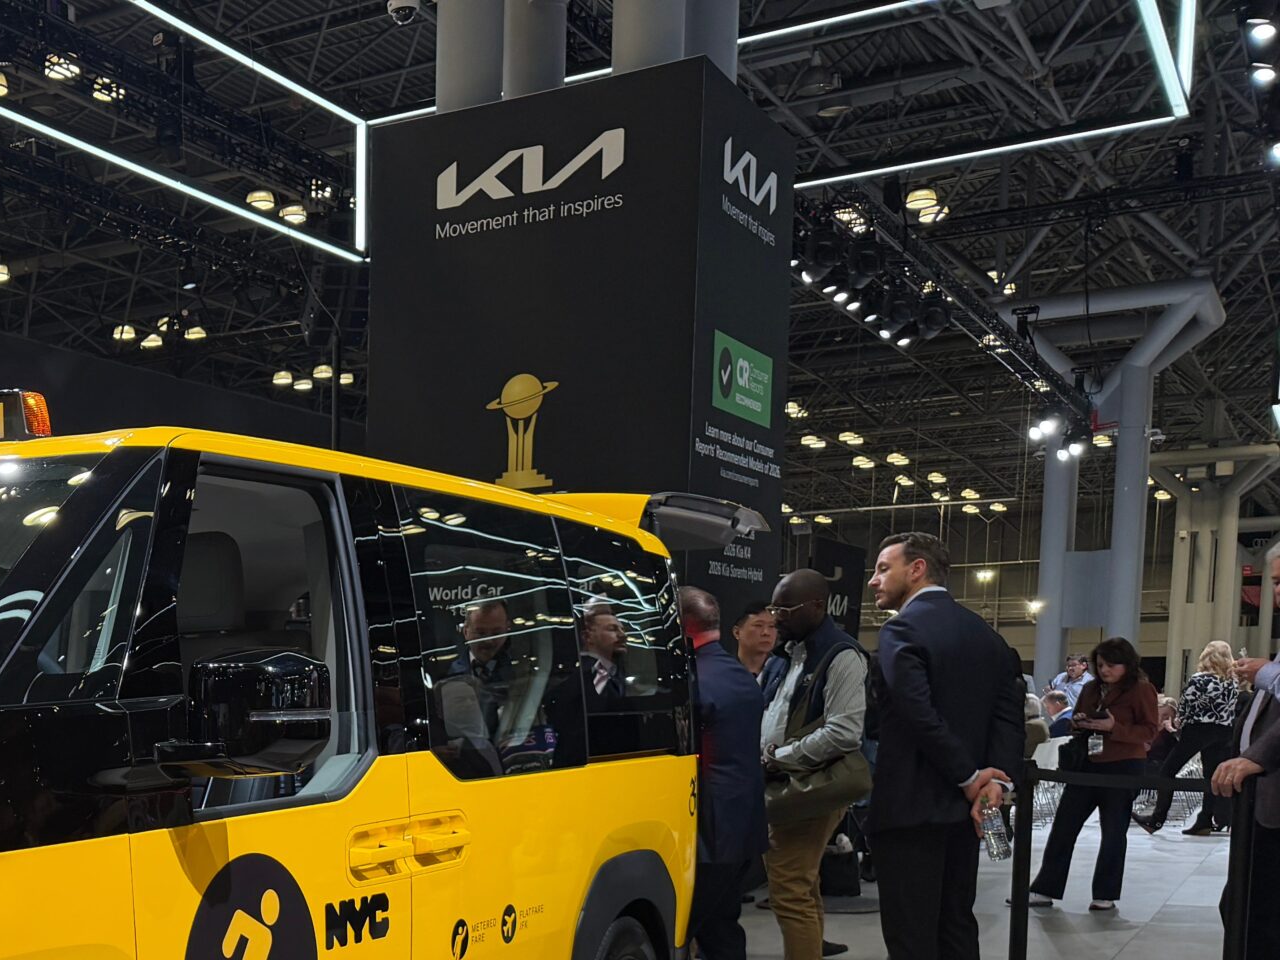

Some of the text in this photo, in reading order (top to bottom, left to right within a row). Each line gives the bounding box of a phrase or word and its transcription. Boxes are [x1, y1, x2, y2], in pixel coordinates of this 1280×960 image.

[436, 127, 625, 210] KIA
[723, 136, 778, 216] KIA
[435, 193, 624, 240] Movement that inspires
[722, 193, 776, 247] Movement that inspires
[736, 357, 750, 390] CR
[705, 421, 775, 459] Learn more about our Consumer
[715, 444, 749, 469] Recommended
[749, 455, 764, 474] Models
[428, 584, 504, 601] World Car
[748, 567, 763, 583] Hybrid
[324, 891, 390, 951] NYC
[470, 918, 497, 934] METERED
[470, 932, 486, 946] FARE
